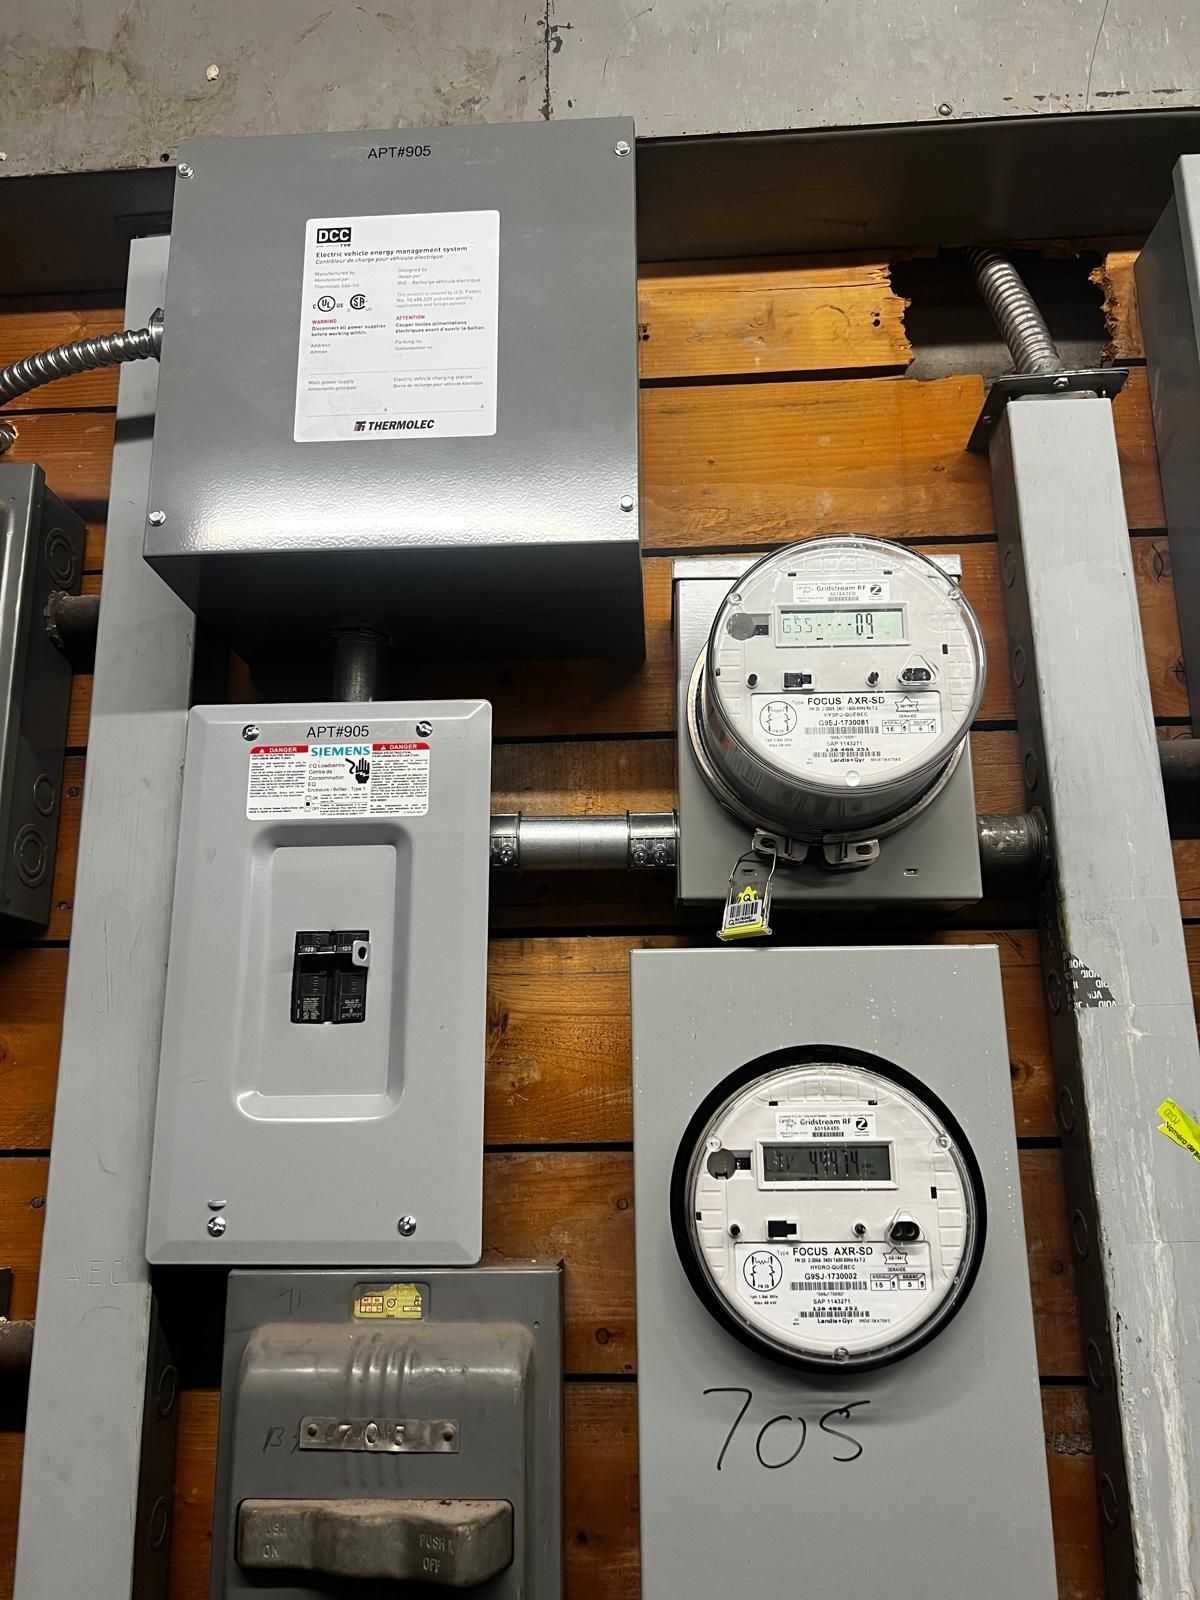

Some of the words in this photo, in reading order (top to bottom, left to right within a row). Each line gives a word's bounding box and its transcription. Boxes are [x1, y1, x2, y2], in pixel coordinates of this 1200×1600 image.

[367, 145, 431, 159] APT#905
[318, 229, 350, 242] DCC
[370, 249, 394, 257] energy
[395, 247, 441, 255] management
[368, 420, 435, 431] THERMOLEC
[807, 697, 842, 706] FOCUS
[847, 696, 885, 705] AXR-SD
[306, 725, 369, 739] APT#905
[311, 745, 370, 757] SIEMENS
[799, 1118, 841, 1126] Gridstream
[792, 1247, 828, 1256] FOCUS
[834, 1246, 873, 1256] AXR-SD
[338, 1421, 405, 1447] 705
[703, 1387, 871, 1470] 705
[423, 1557, 440, 1573] OFF
